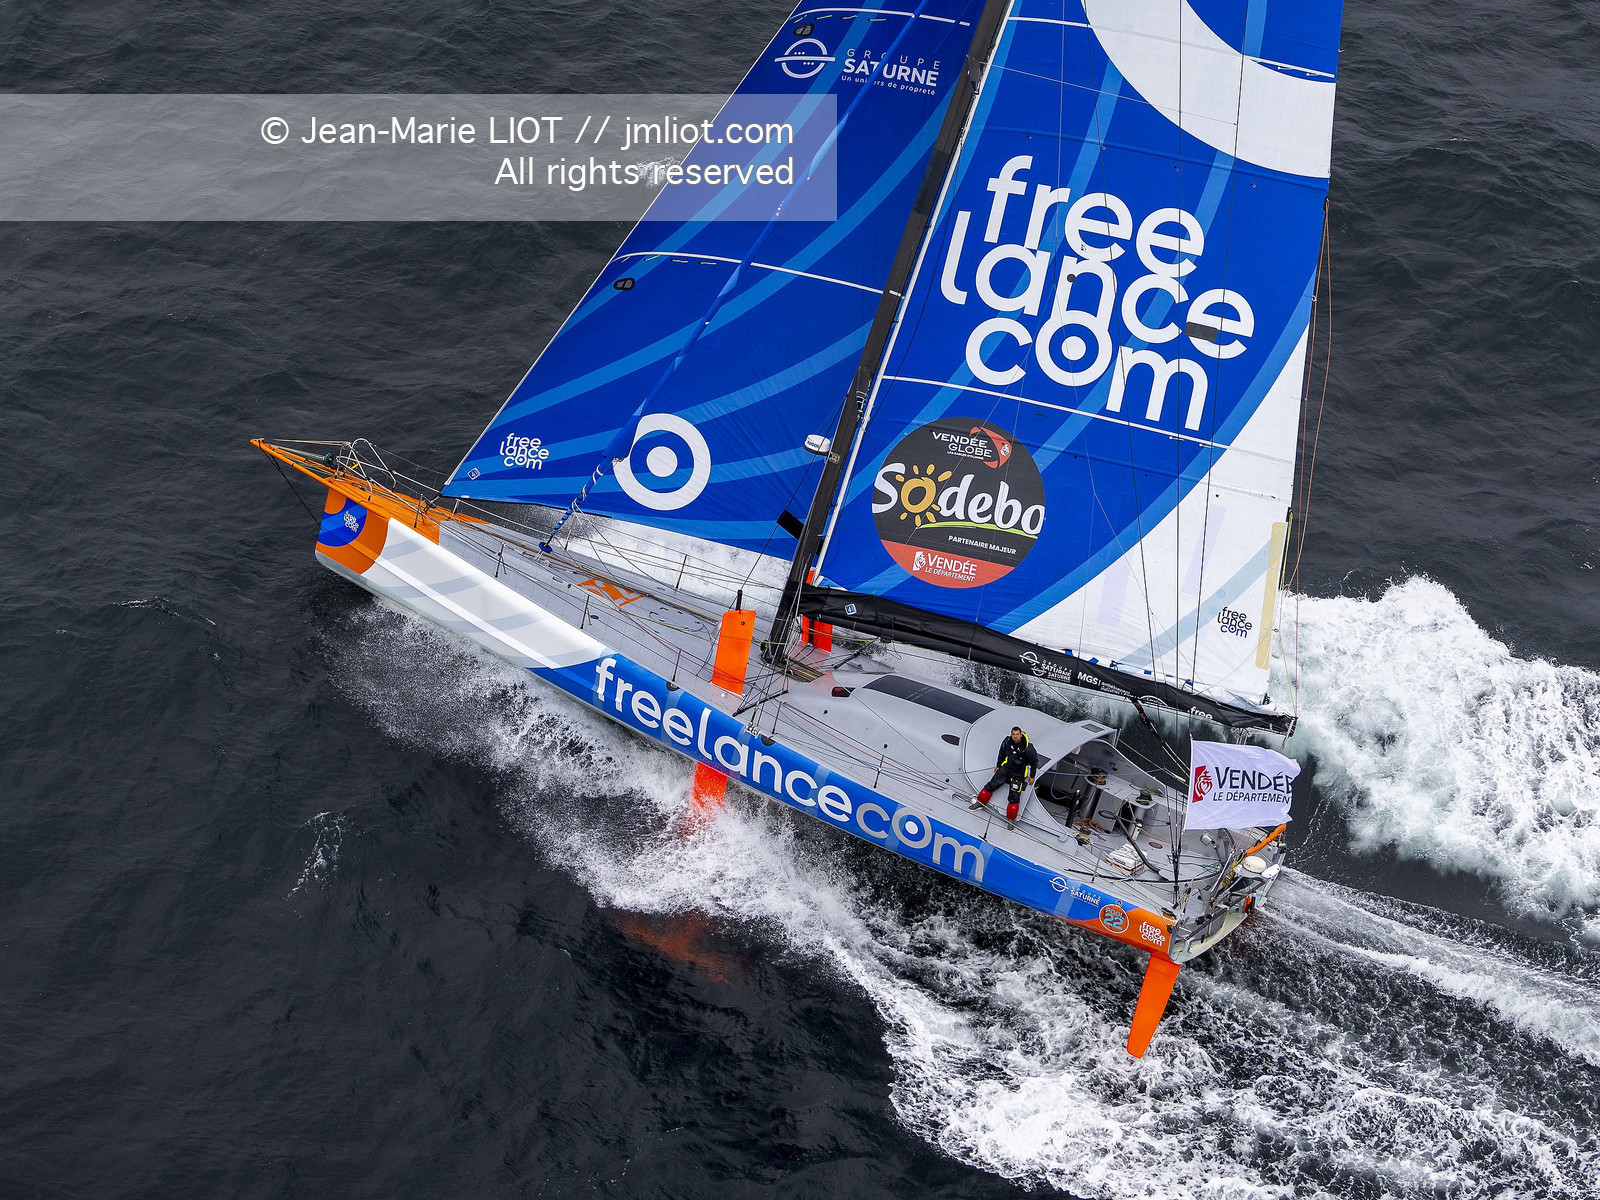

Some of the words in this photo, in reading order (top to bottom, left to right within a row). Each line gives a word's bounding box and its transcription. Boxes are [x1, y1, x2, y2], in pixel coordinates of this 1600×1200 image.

[843, 58, 939, 87] SATURNE
[900, 84, 936, 96] propreté
[984, 155, 1204, 278] free
[941, 210, 1254, 359] lance
[965, 317, 1208, 431] com
[506, 432, 542, 448] free
[932, 432, 988, 448] VENDÉE
[499, 441, 550, 459] lance
[948, 443, 992, 457] GLOBE
[504, 456, 542, 470] com
[872, 462, 1045, 535] Sodebo
[948, 535, 988, 549] PARTENAIRE
[988, 543, 1017, 555] MAJEUR
[928, 552, 977, 575] VENDÉE
[933, 568, 975, 582] DÉPARTEMENT
[1217, 612, 1252, 630] lance
[1222, 606, 1247, 621] free
[1220, 625, 1247, 638] com
[1213, 791, 1223, 802] LE
[1226, 790, 1292, 804] DÉPARTEMEN
[1070, 889, 1100, 905] SATURNE
[1105, 907, 1124, 919] POOL
[1103, 913, 1123, 930] 22
